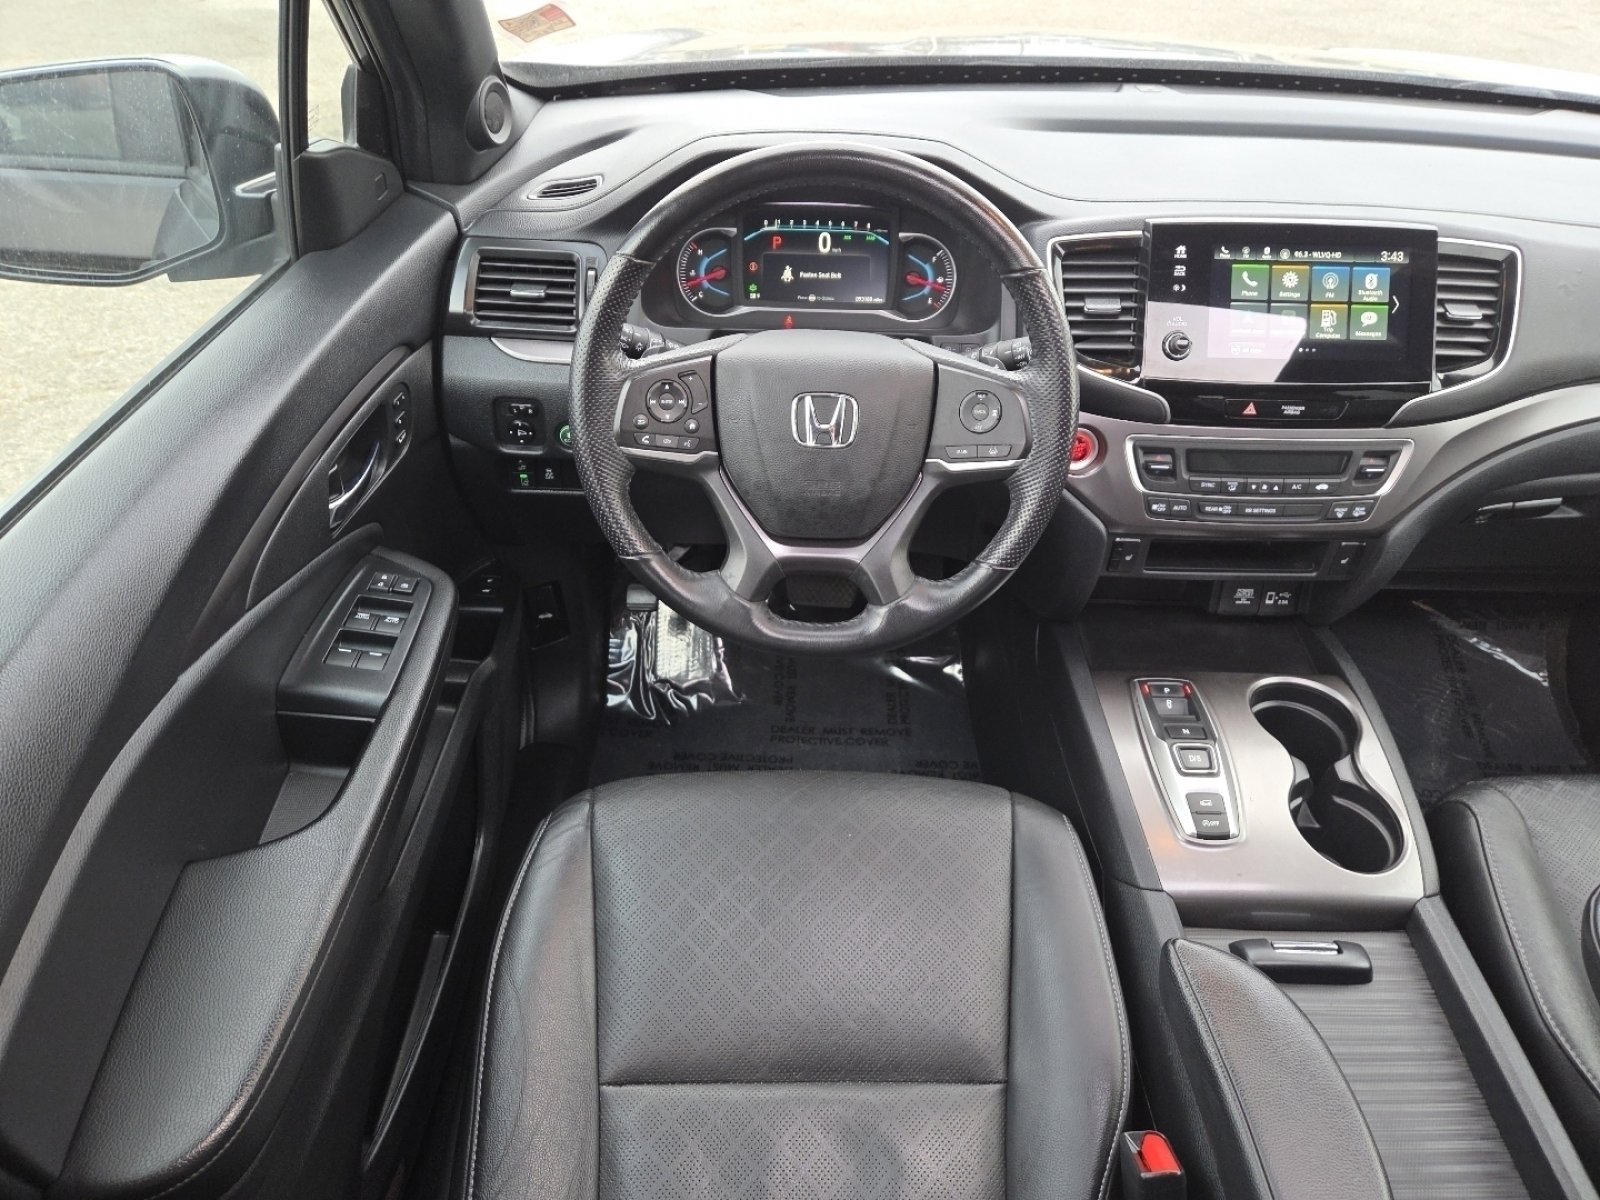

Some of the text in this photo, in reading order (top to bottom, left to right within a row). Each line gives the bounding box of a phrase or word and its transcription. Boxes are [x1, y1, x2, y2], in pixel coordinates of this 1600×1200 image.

[772, 236, 782, 250] P
[818, 231, 832, 254] 0
[1380, 250, 1405, 263] 3:43
[770, 725, 912, 737] DEALER MUST REMOVE
[769, 734, 889, 747] PROTECTIVE COVER
